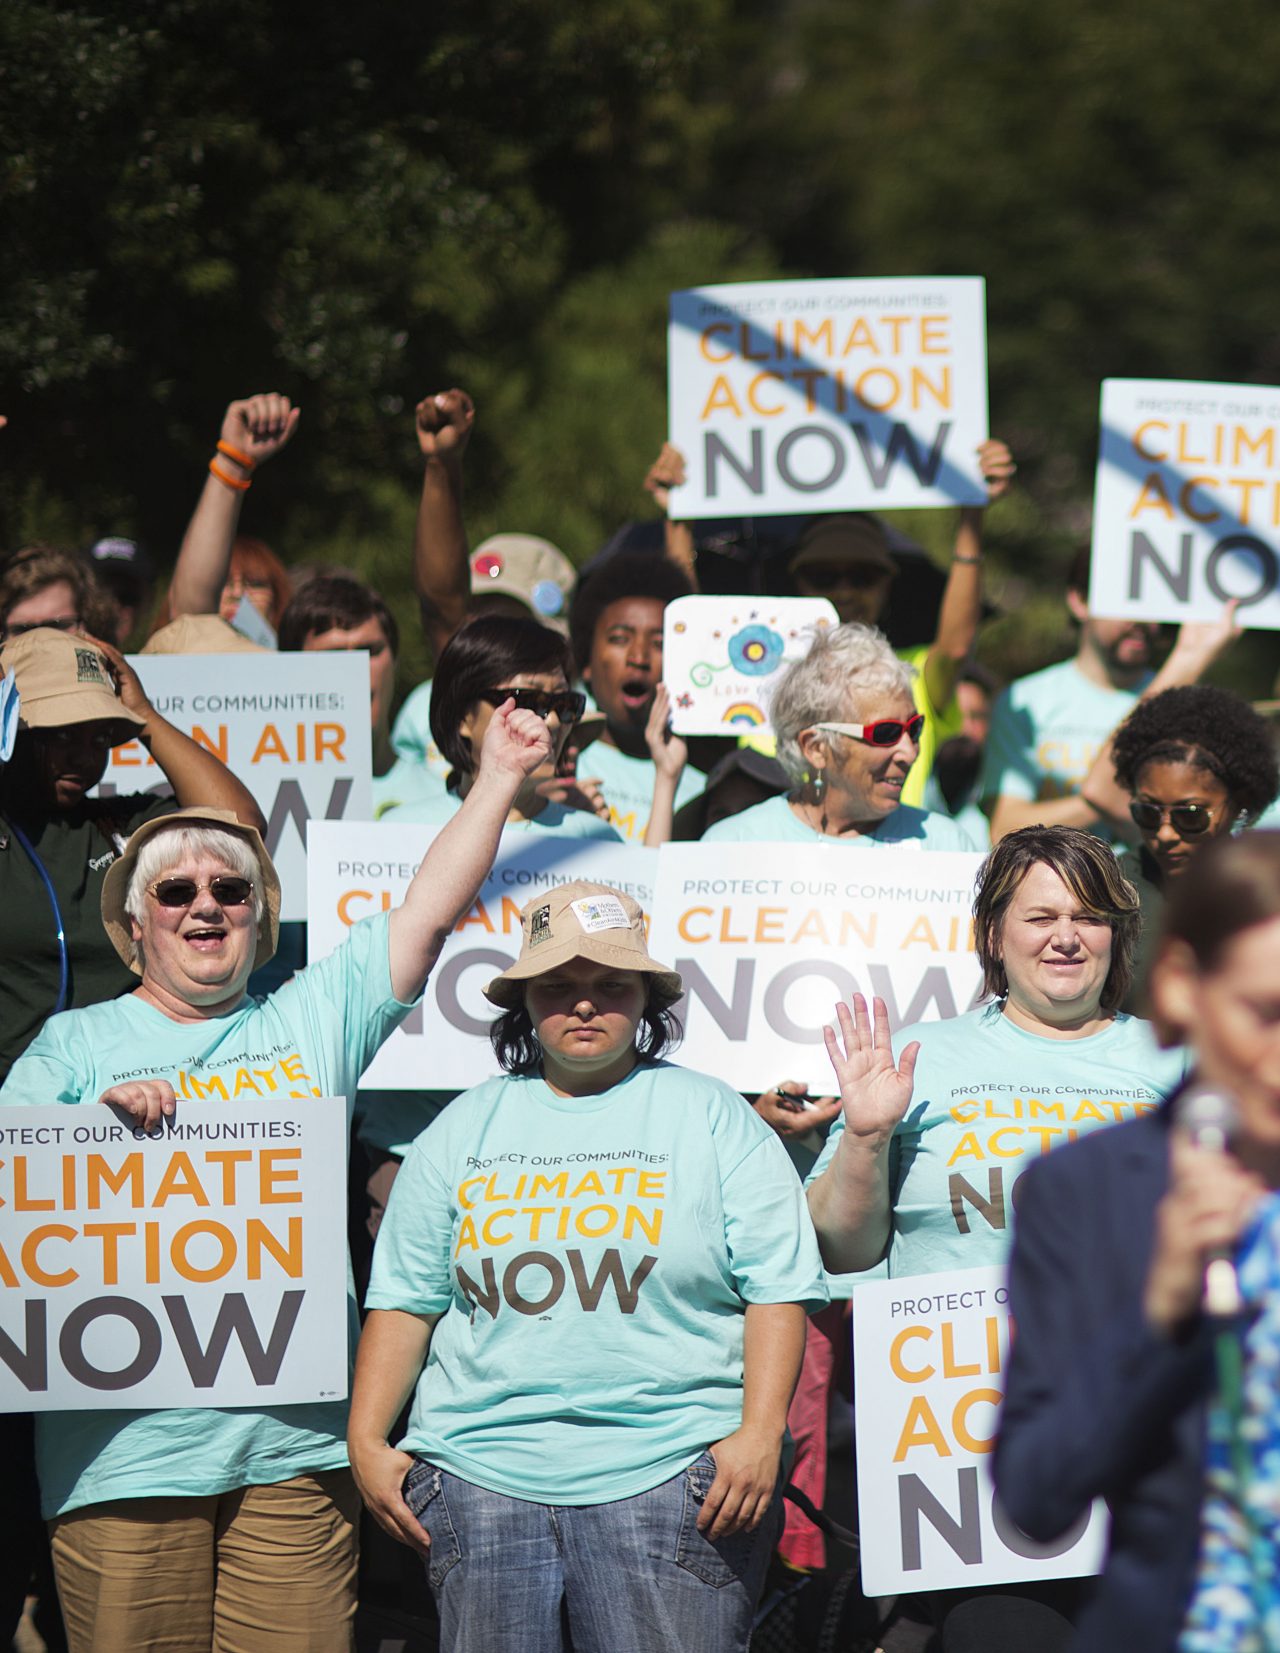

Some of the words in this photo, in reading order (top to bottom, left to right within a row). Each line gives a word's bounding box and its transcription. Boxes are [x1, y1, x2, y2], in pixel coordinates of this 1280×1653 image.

[698, 315, 953, 364] CLIMATE
[699, 365, 953, 421] ACTION
[704, 420, 953, 498] NOW
[192, 693, 345, 714] COMMUNITIES:
[250, 722, 347, 765] AIR
[683, 879, 783, 896] PROTECT
[790, 881, 837, 897] OUR
[677, 906, 879, 950] CLEAN
[112, 1063, 178, 1082] PROTECT
[951, 1083, 1016, 1097] PROTECT
[1019, 1085, 1051, 1096] OUR
[73, 1124, 123, 1144] OUR
[131, 1120, 303, 1142] COMMUNITIES:
[0, 1147, 304, 1212] LIMATE
[467, 1153, 527, 1170] PROTECT
[531, 1156, 563, 1166] OUR
[566, 1149, 669, 1164] COMMUNITIES:
[457, 1167, 668, 1211] CLIMATE
[454, 1204, 664, 1260] ACTION
[455, 1248, 659, 1326] NOW
[890, 1290, 986, 1318] PROTECT
